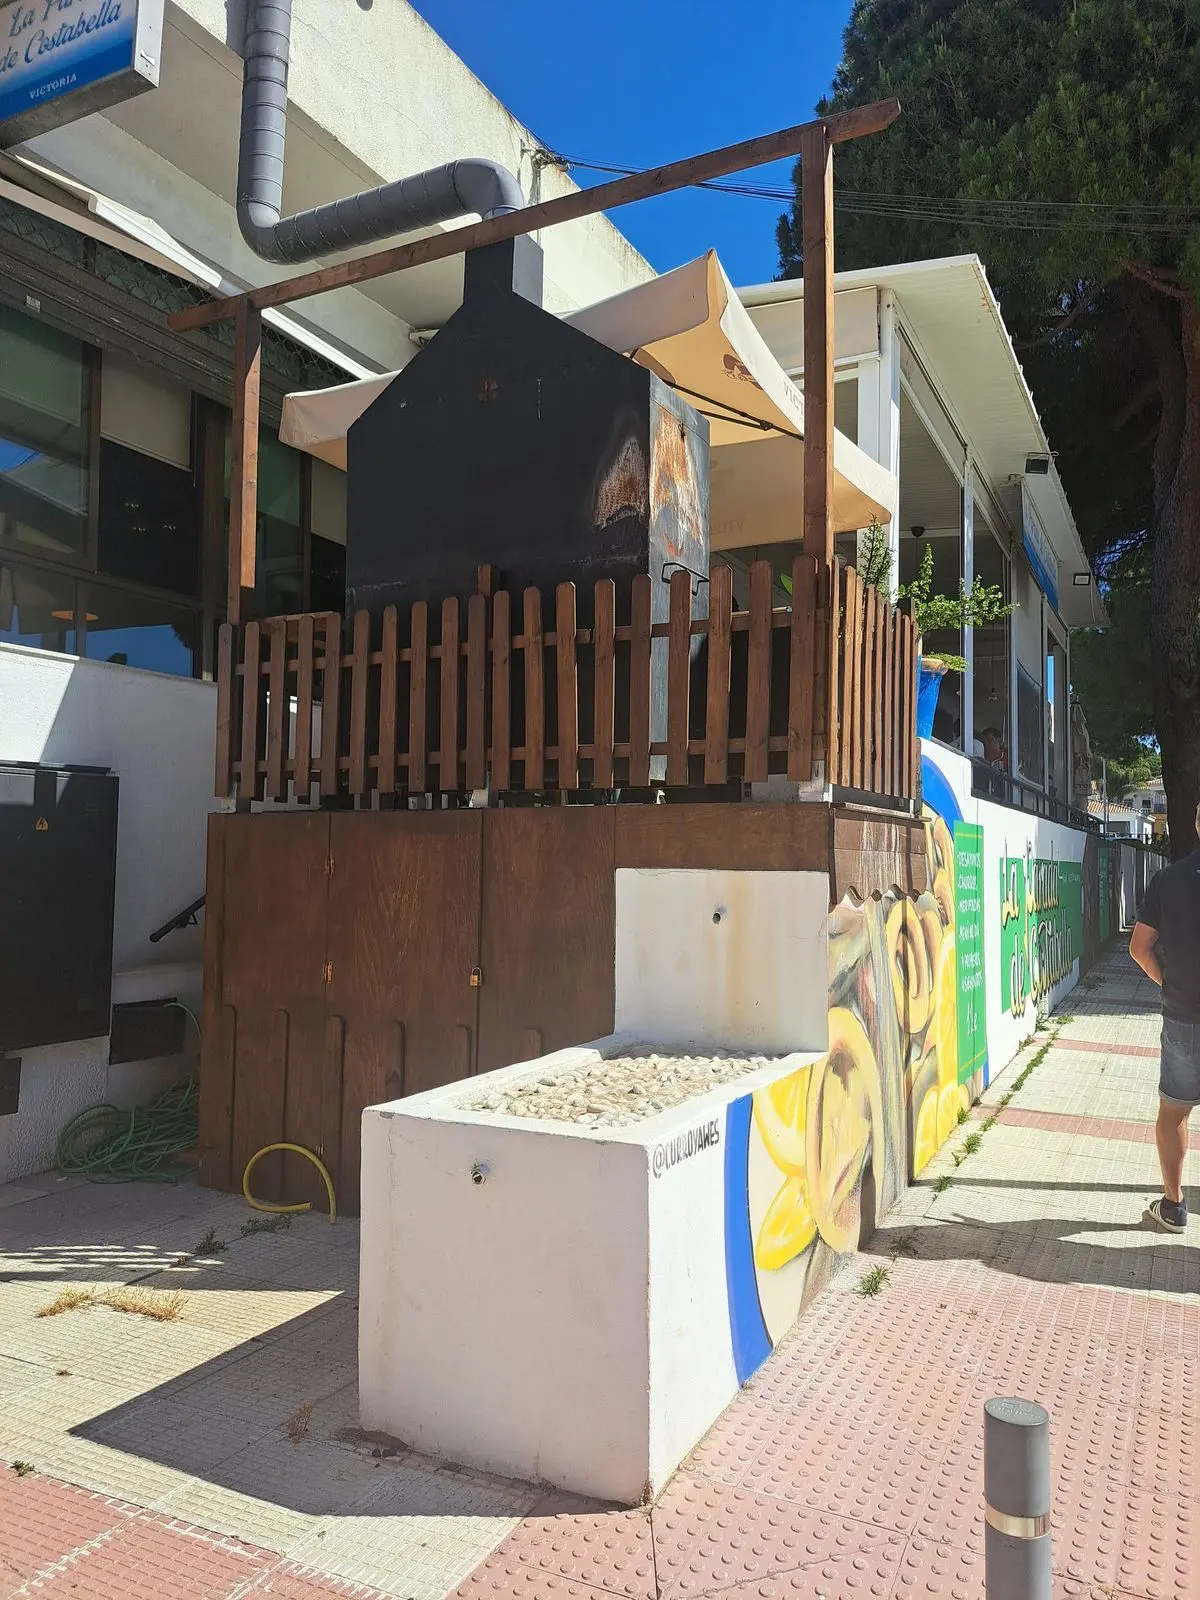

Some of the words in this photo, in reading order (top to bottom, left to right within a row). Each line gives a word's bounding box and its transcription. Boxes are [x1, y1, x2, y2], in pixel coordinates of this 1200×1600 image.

[0, 46, 19, 72] de
[24, 0, 122, 64] Costabella
[8, 6, 36, 37] La
[29, 73, 77, 99] VICTORIA
